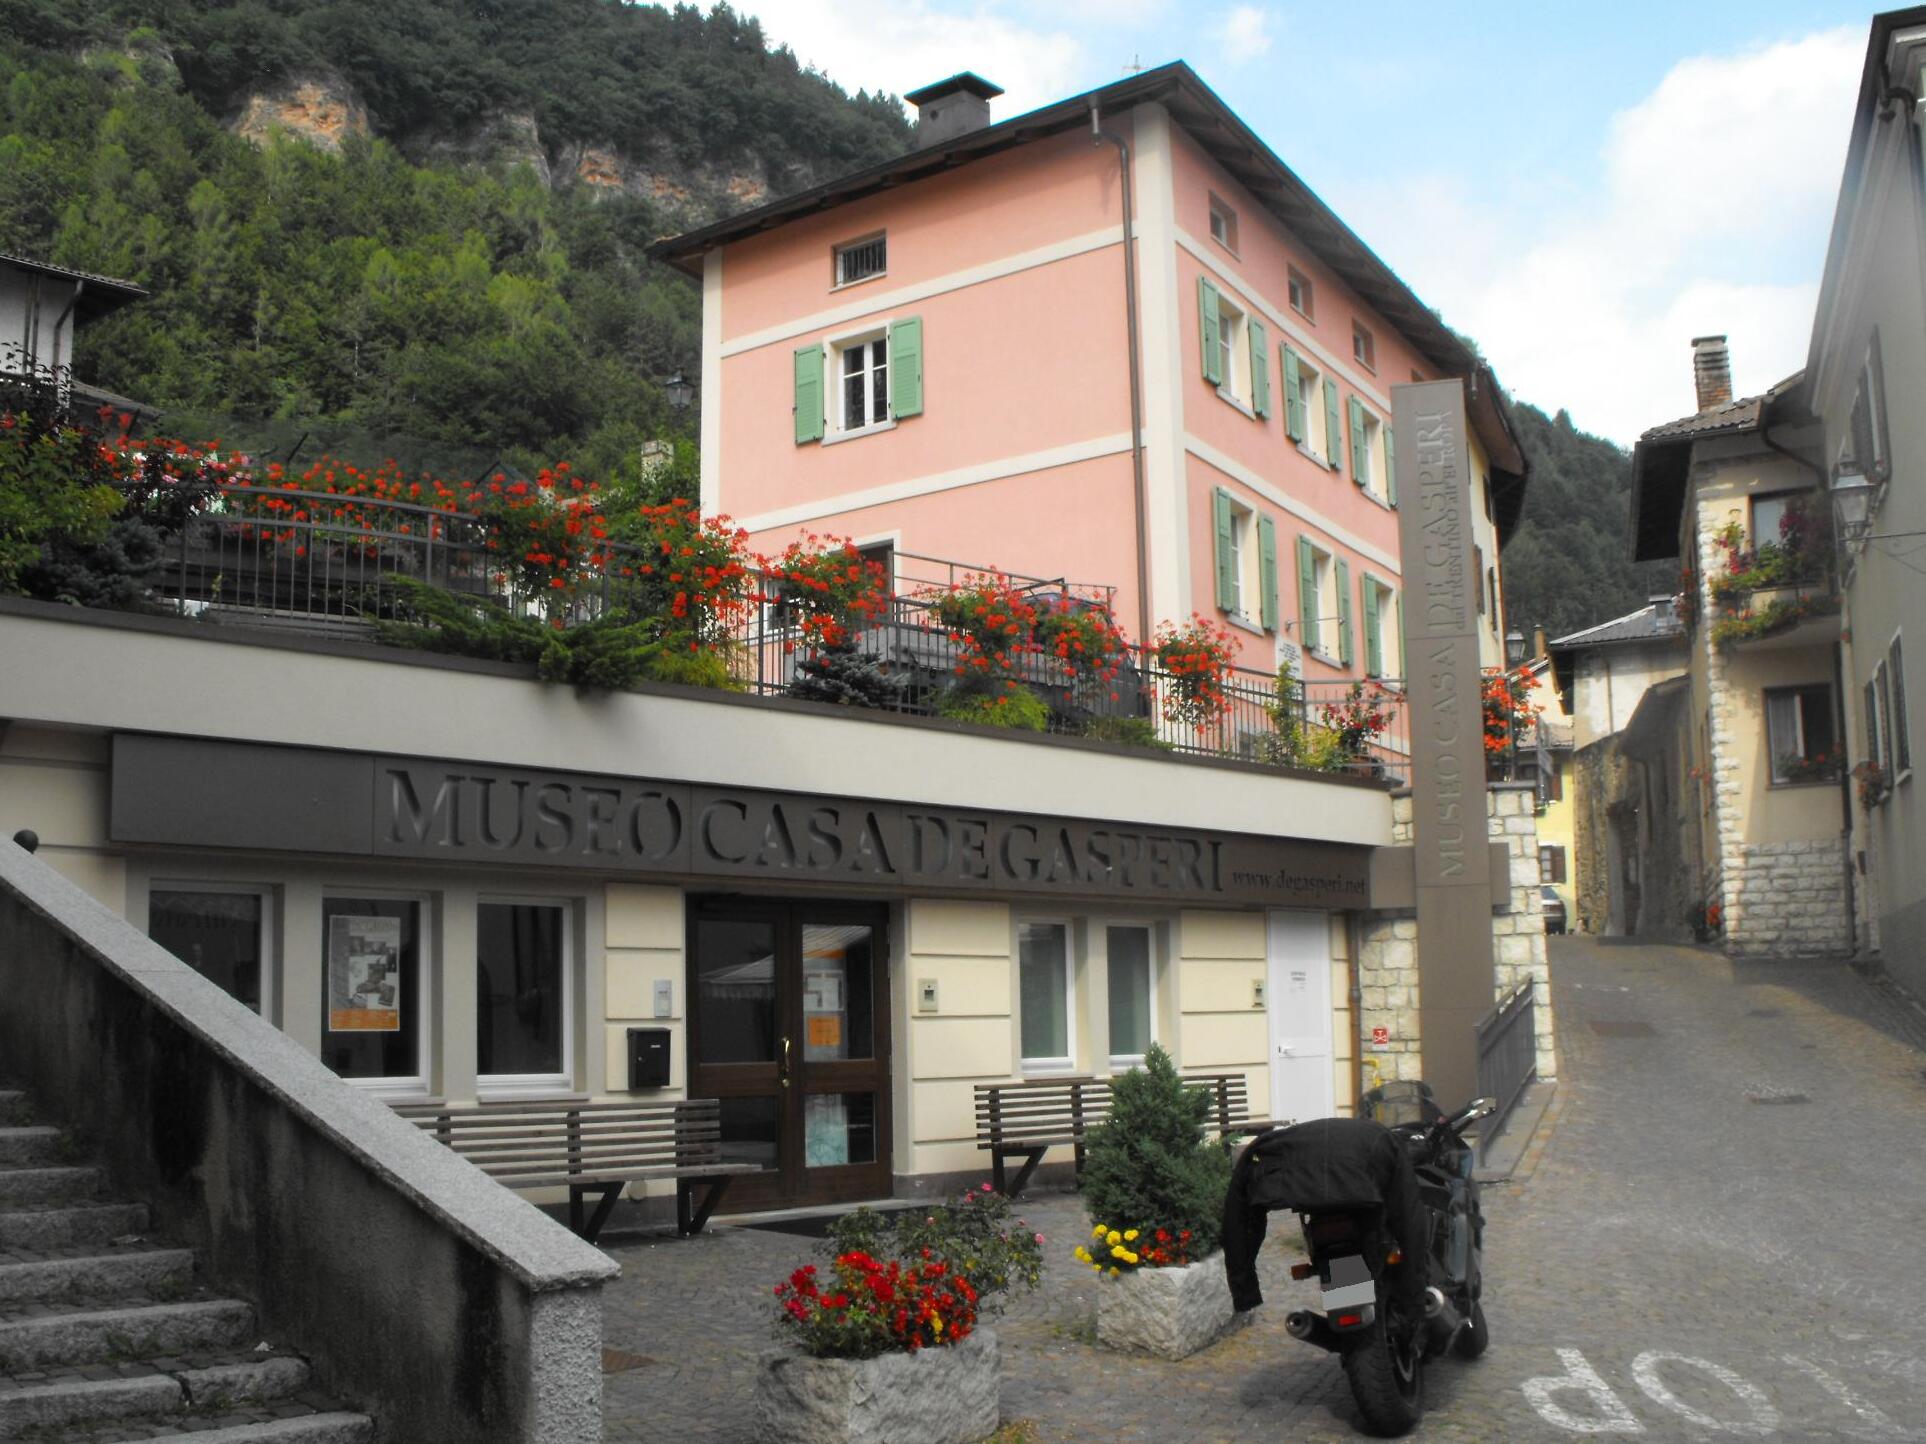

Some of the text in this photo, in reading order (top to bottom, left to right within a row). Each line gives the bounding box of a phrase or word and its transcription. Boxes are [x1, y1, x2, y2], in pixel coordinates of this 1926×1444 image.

[1416, 410, 1465, 878] MUSEO CASA DE GASPERI
[385, 768, 1224, 892] MUSEO CASA DE GASPERI
[1231, 868, 1366, 898] www.degasperi.net
